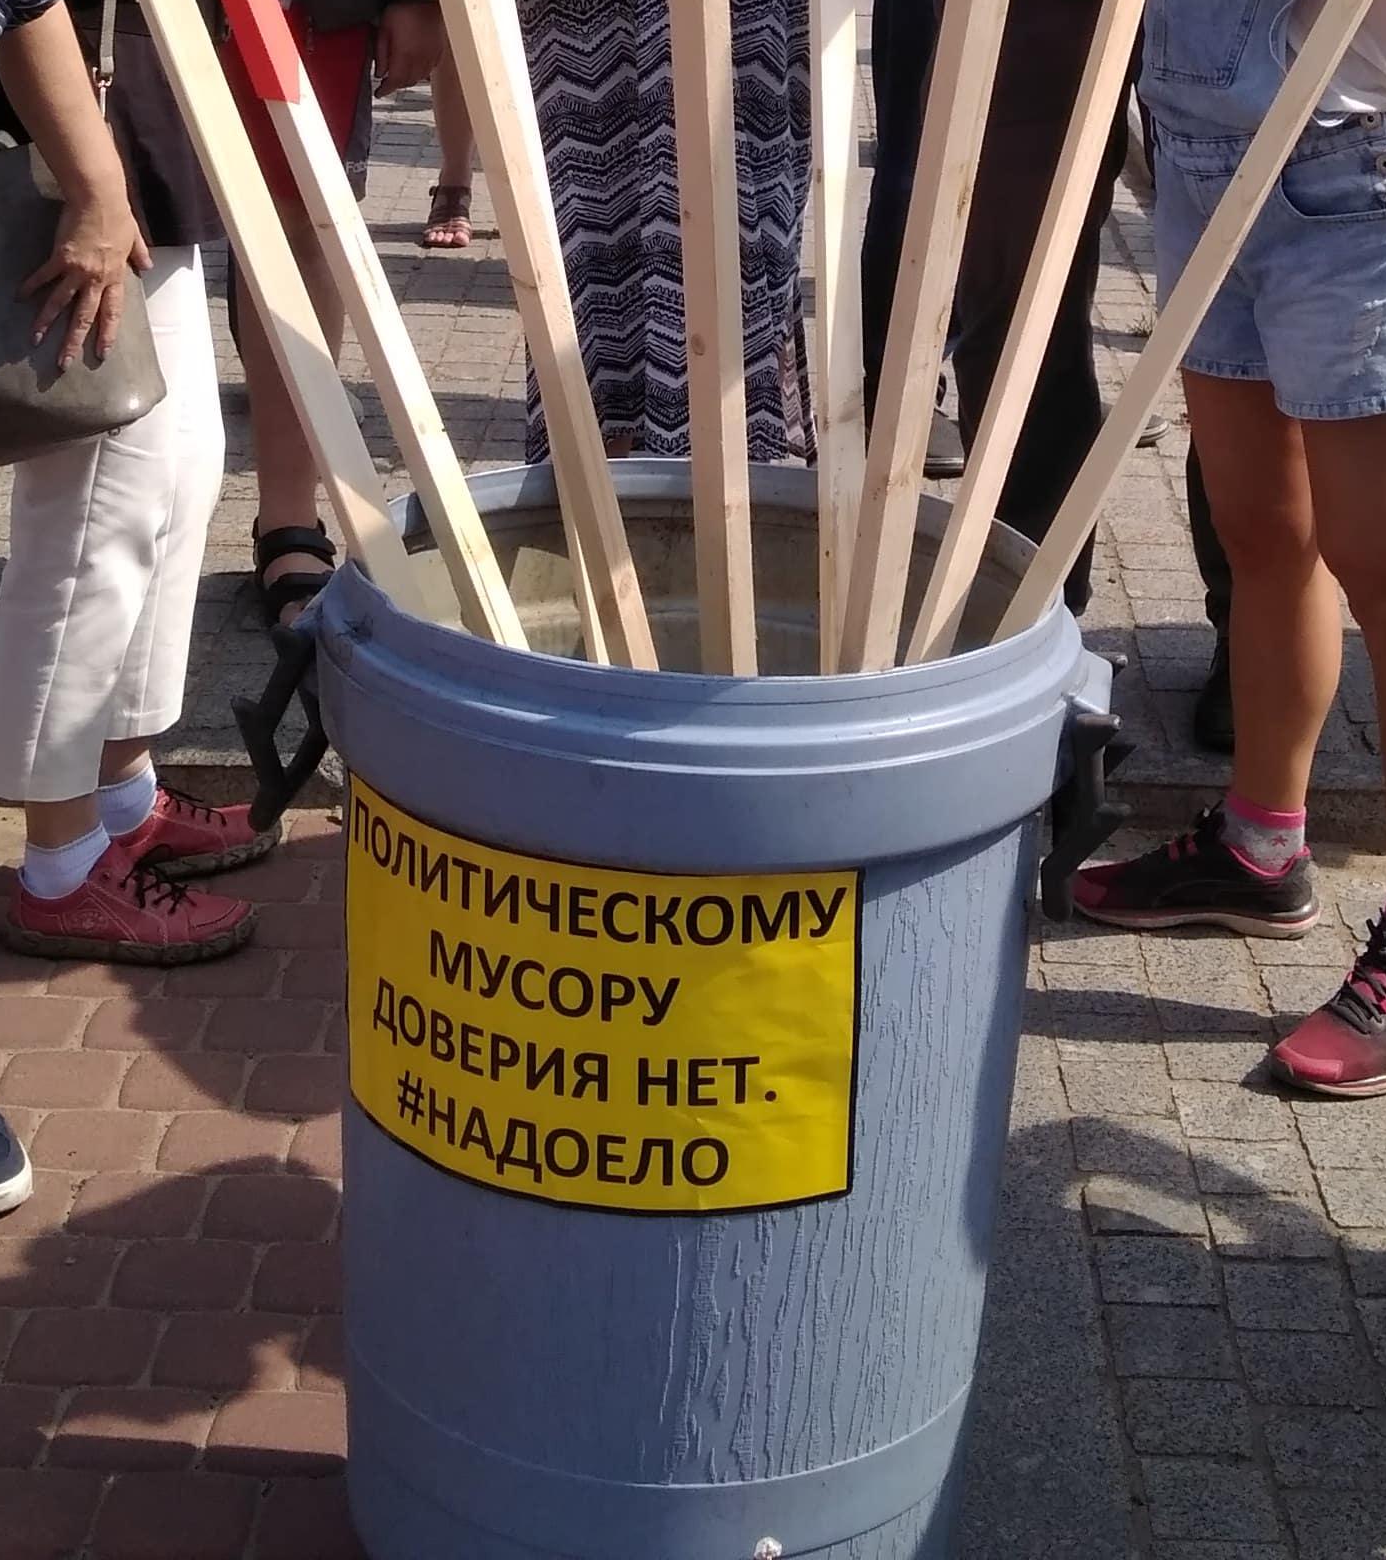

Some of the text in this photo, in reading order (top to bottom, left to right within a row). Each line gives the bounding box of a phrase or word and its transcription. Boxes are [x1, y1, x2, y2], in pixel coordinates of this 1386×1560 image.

[354, 797, 847, 946] ПОЛИТИЧЕСКОМУ
[429, 930, 681, 1027] МУСОРУ
[373, 977, 779, 1107] ДОВЕРИЯ НЕТ.
[397, 1070, 729, 1187] #НАДОЕЛО
